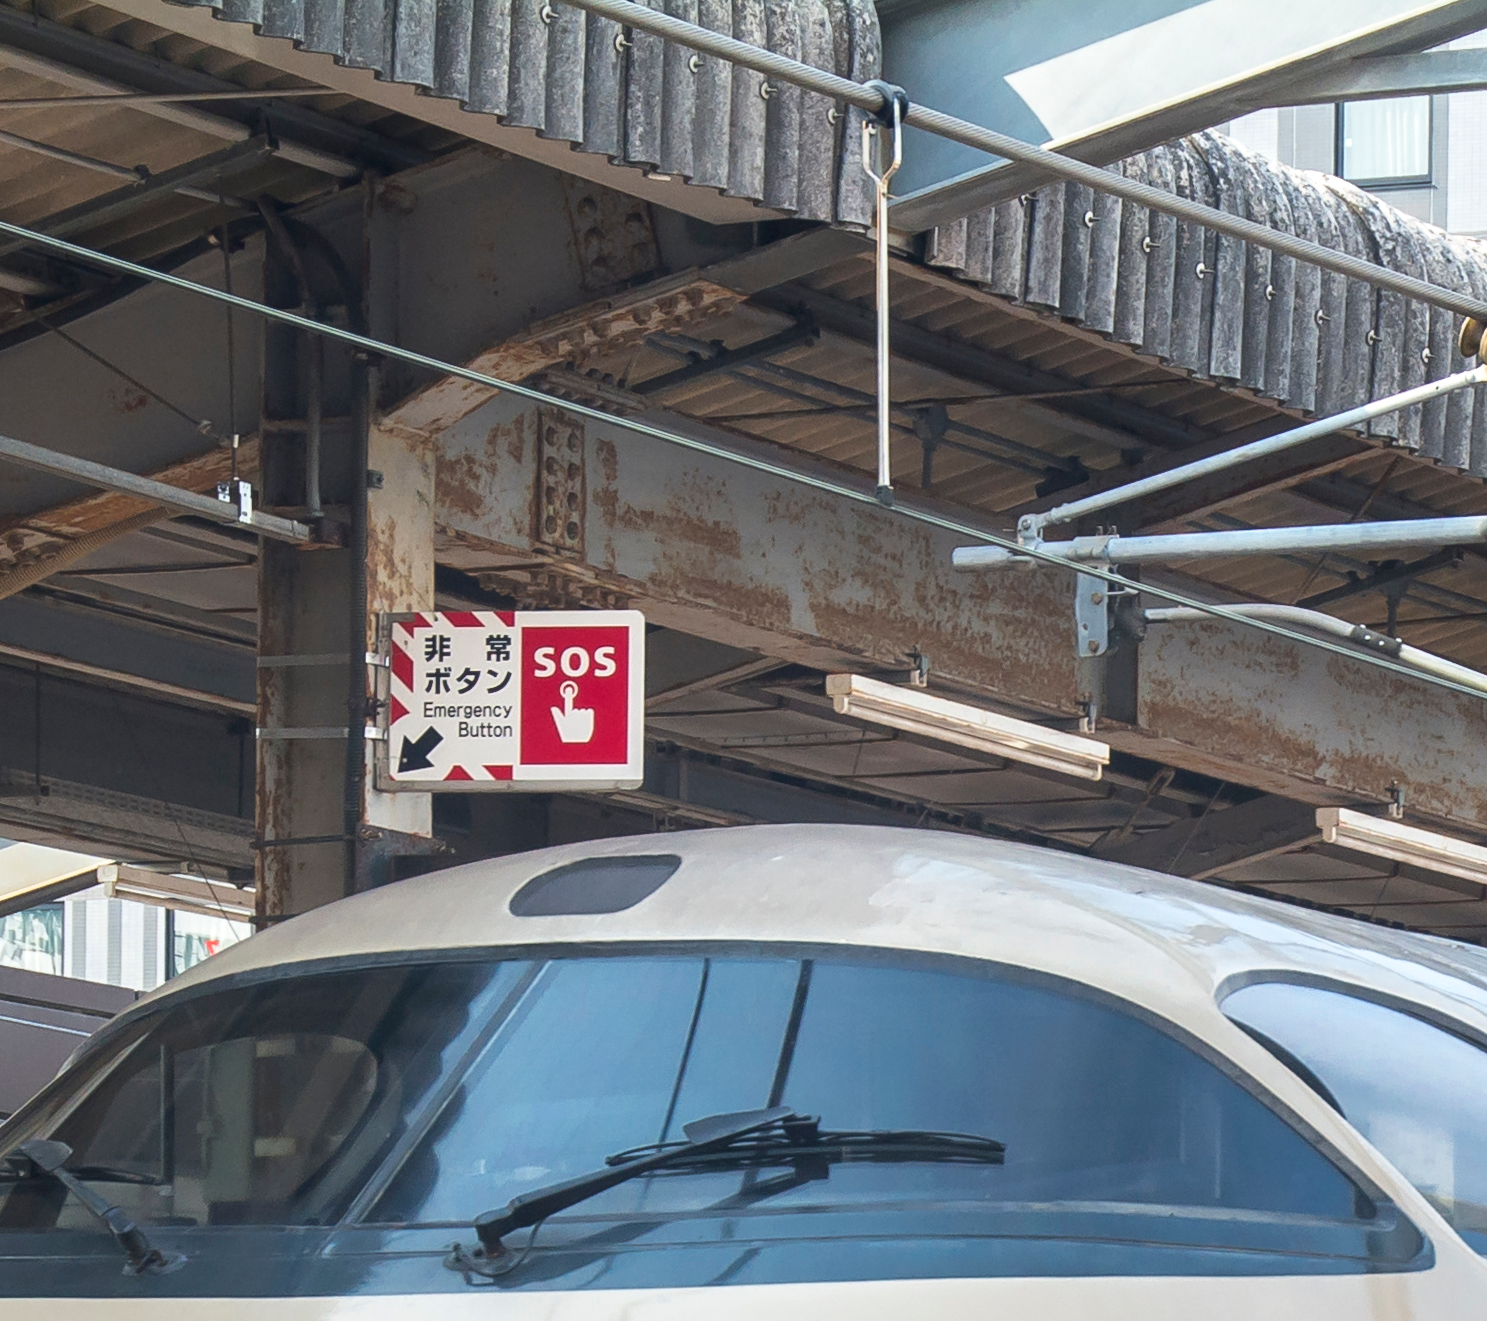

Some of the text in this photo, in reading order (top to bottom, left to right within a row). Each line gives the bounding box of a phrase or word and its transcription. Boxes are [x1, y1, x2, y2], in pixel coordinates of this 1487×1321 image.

[424, 634, 512, 663] 非常
[533, 645, 617, 678] SOS
[425, 667, 512, 694] ボタン
[423, 702, 513, 721] Emergency
[458, 721, 513, 738] Button
